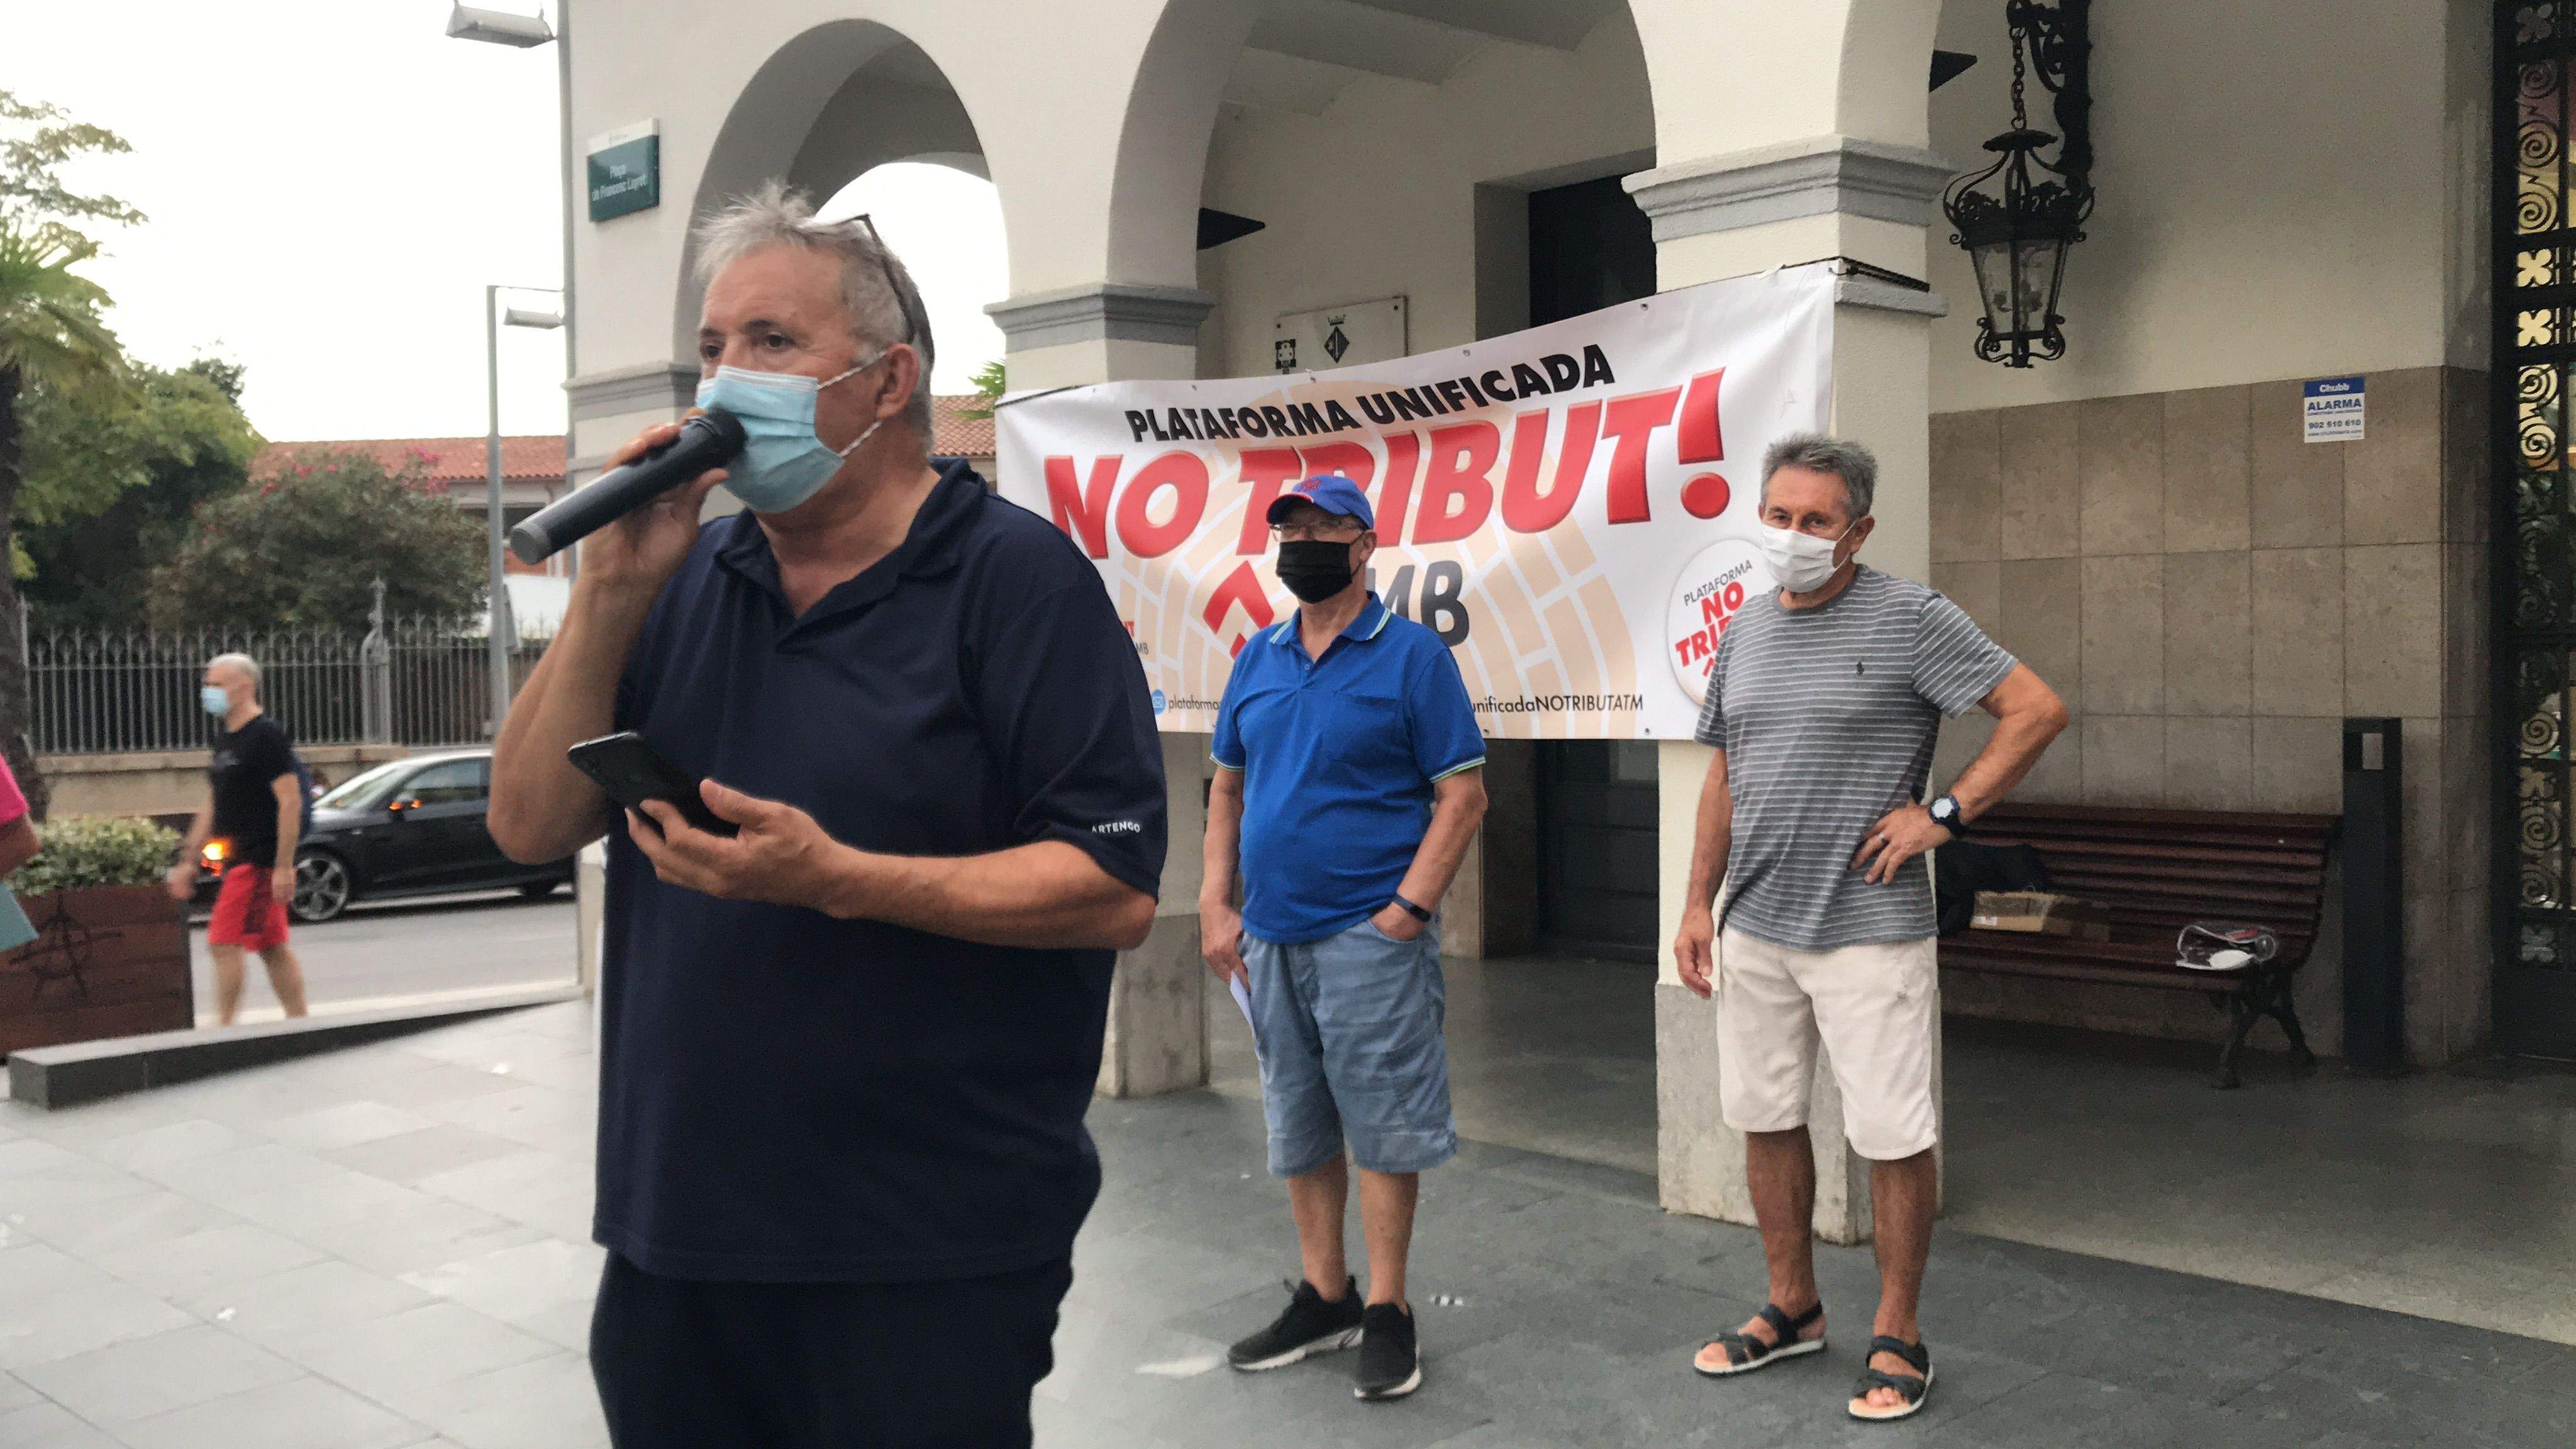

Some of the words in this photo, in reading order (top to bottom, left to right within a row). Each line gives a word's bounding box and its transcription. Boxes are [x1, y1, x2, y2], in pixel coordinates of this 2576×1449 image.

[1125, 400, 1362, 442] PLATAFORMA
[1356, 344, 1615, 425] UNIFICADA
[2308, 398, 2362, 411] ALARMA
[1044, 450, 1209, 559] NO
[1366, 560, 1470, 647] MB
[1684, 560, 1753, 606] PLATAFORMA
[1701, 582, 1744, 625] NO
[1169, 694, 1221, 713] plataforma
[1092, 821, 1141, 833] ARTENGO
